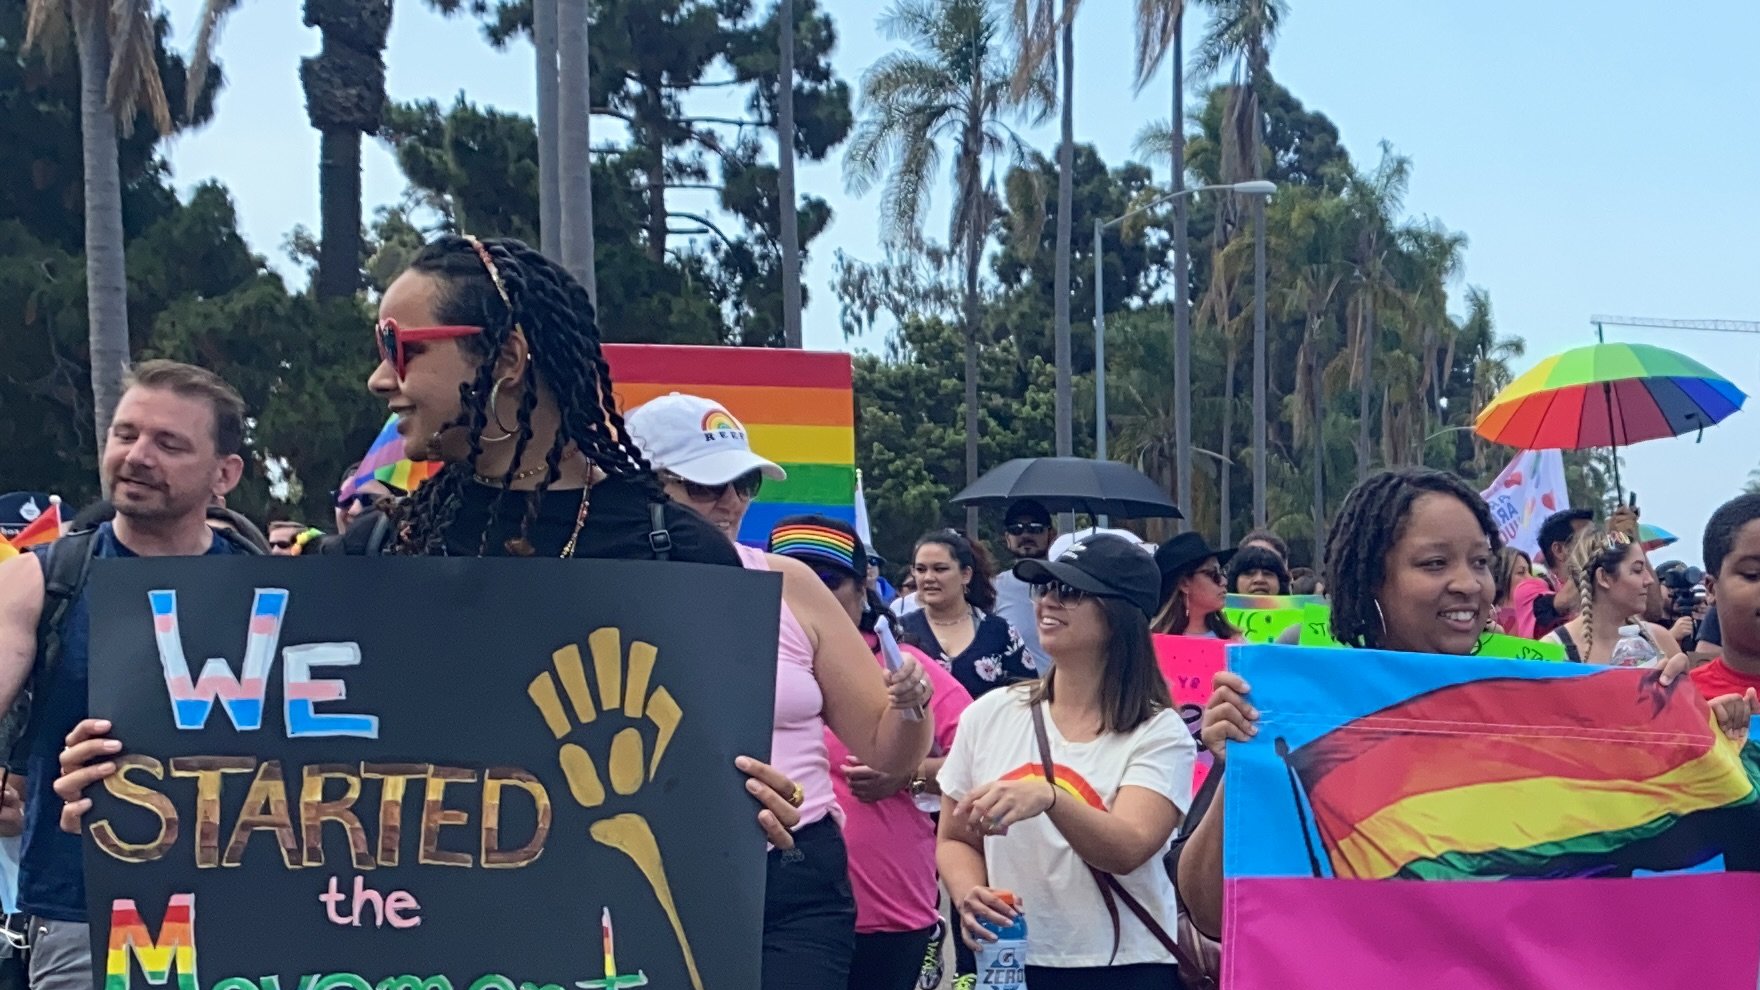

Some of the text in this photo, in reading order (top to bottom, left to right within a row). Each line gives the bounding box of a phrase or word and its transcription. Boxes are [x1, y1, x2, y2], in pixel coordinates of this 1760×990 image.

[148, 587, 379, 740] WE
[89, 753, 554, 870] STARTED
[318, 874, 422, 929] the
[982, 968, 1024, 985] ZERO
